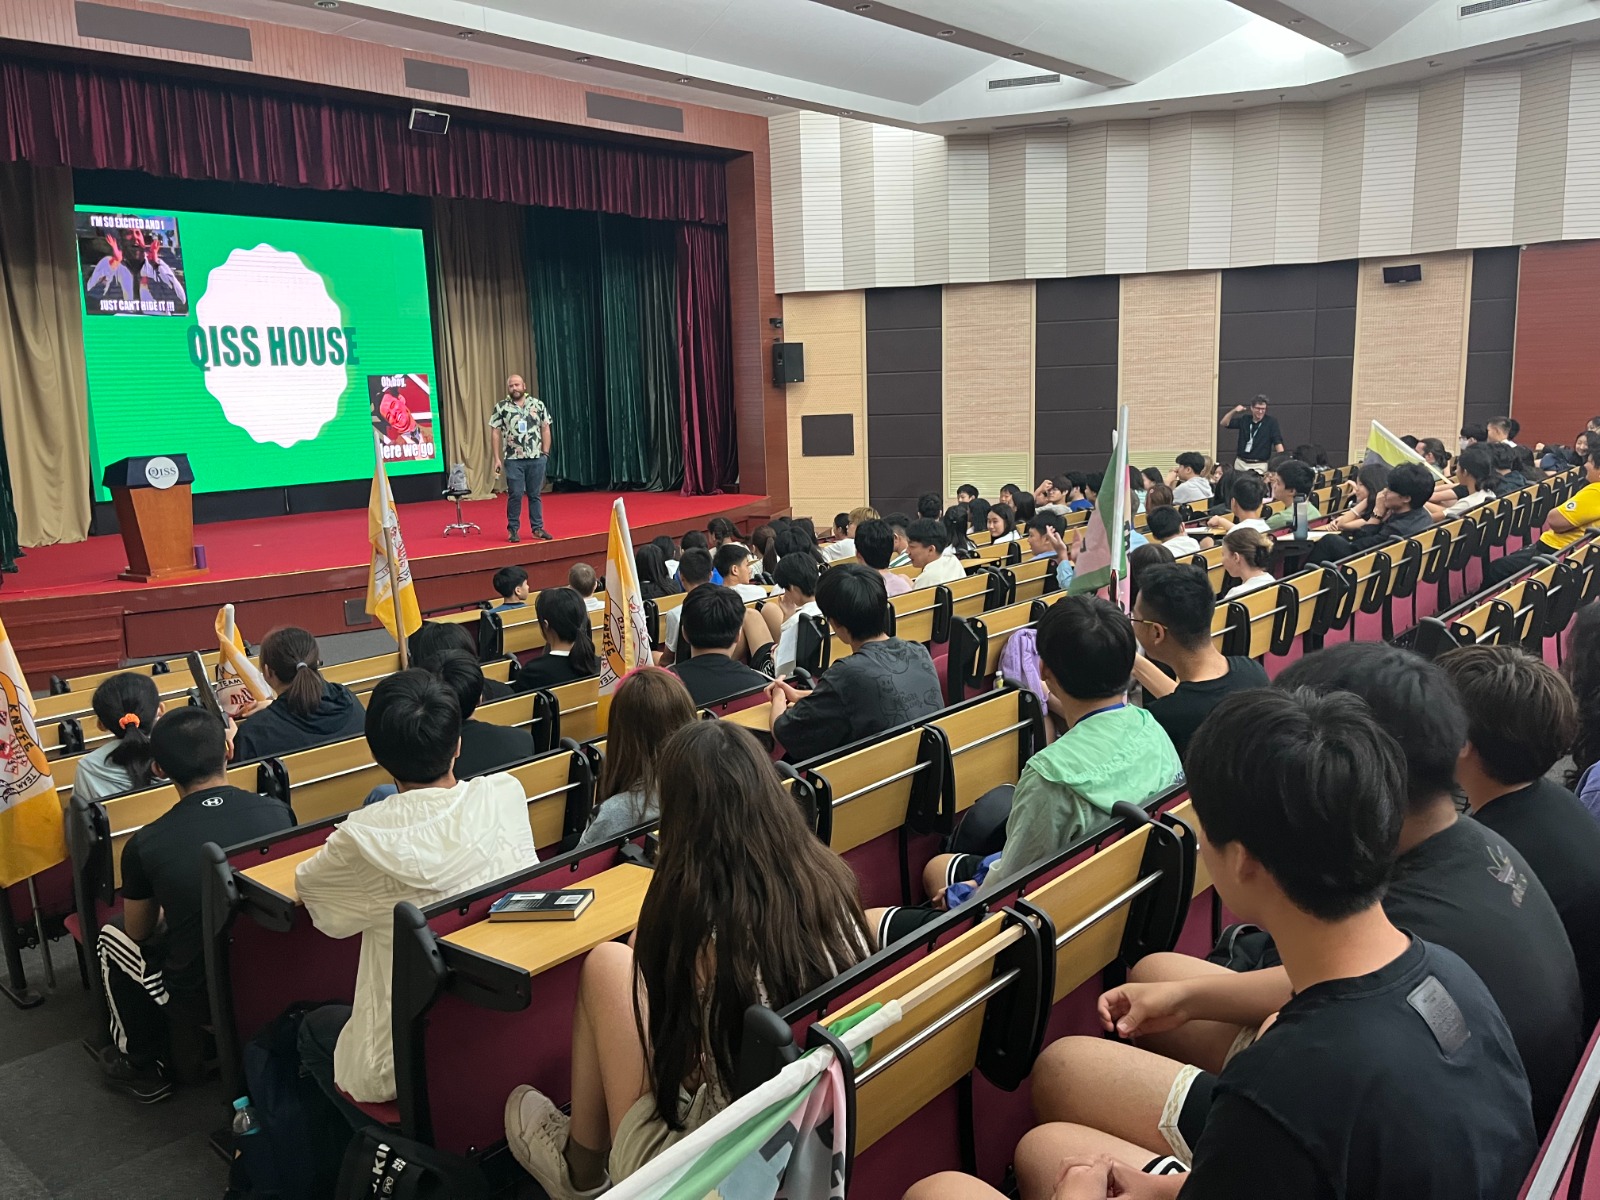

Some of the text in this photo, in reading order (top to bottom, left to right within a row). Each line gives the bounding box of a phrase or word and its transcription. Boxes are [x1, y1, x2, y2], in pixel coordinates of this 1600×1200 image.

[90, 215, 165, 230] I'M SO EXCITED AND I
[100, 300, 118, 311] JUST
[118, 300, 140, 311] CAN'T
[140, 301, 158, 312] HIDE
[158, 301, 166, 312] IT
[187, 325, 360, 372] QISS HOUSE
[381, 376, 391, 388] Oh
[402, 443, 418, 458] we
[420, 442, 433, 458] go
[148, 467, 176, 479] QISS
[603, 613, 615, 656] KNIFE
[218, 679, 240, 687] TEAM
[9, 703, 34, 752] KNIFE
[16, 772, 36, 790] TEAM
